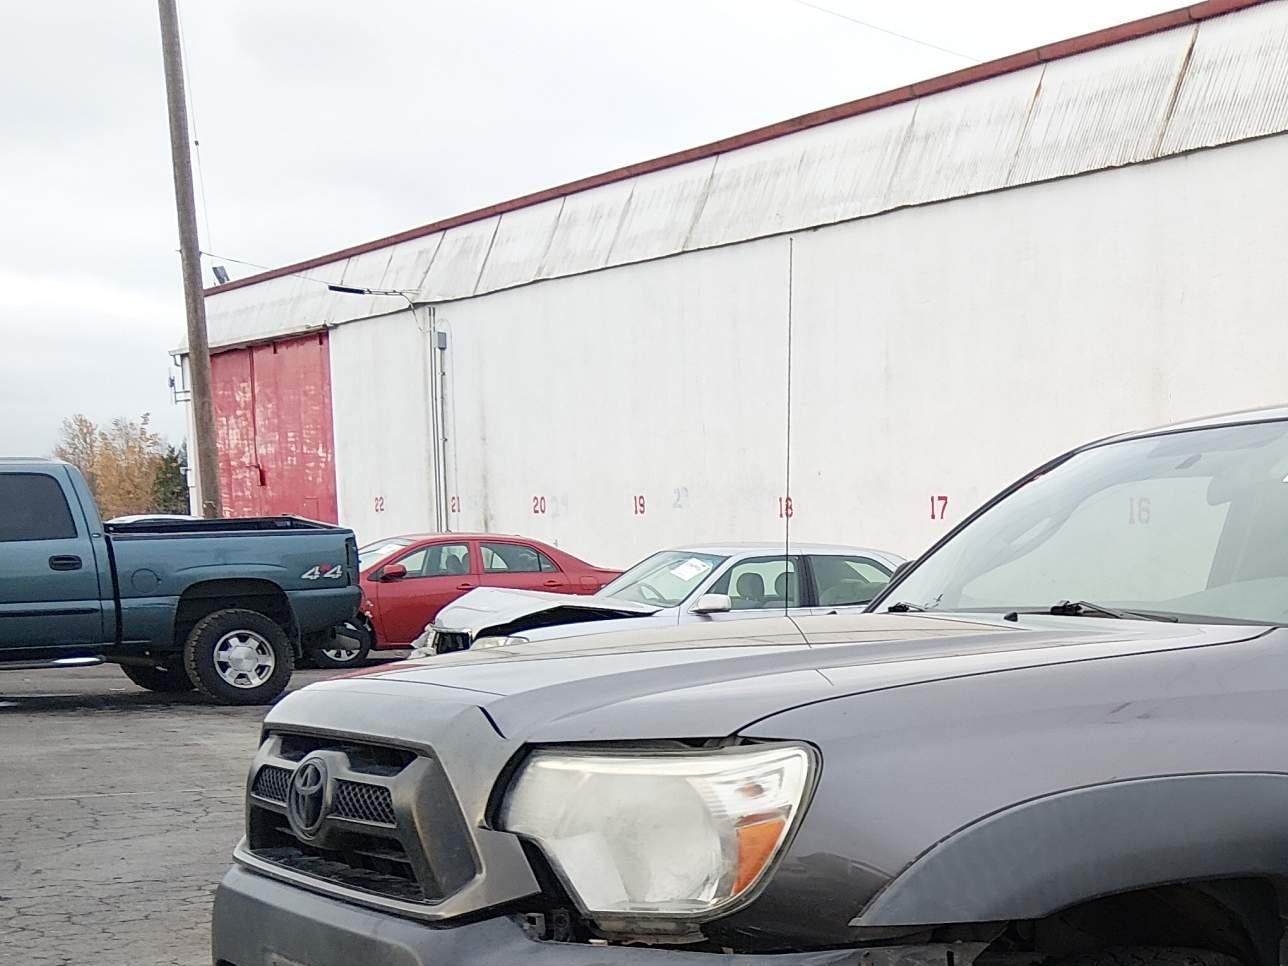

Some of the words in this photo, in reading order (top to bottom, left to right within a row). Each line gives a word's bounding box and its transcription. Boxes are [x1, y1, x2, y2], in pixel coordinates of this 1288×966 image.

[374, 496, 385, 513] 22
[451, 496, 461, 513] 21
[533, 496, 546, 514] 20
[633, 495, 646, 515] 19
[930, 495, 949, 520] 17
[1127, 497, 1151, 525] 16
